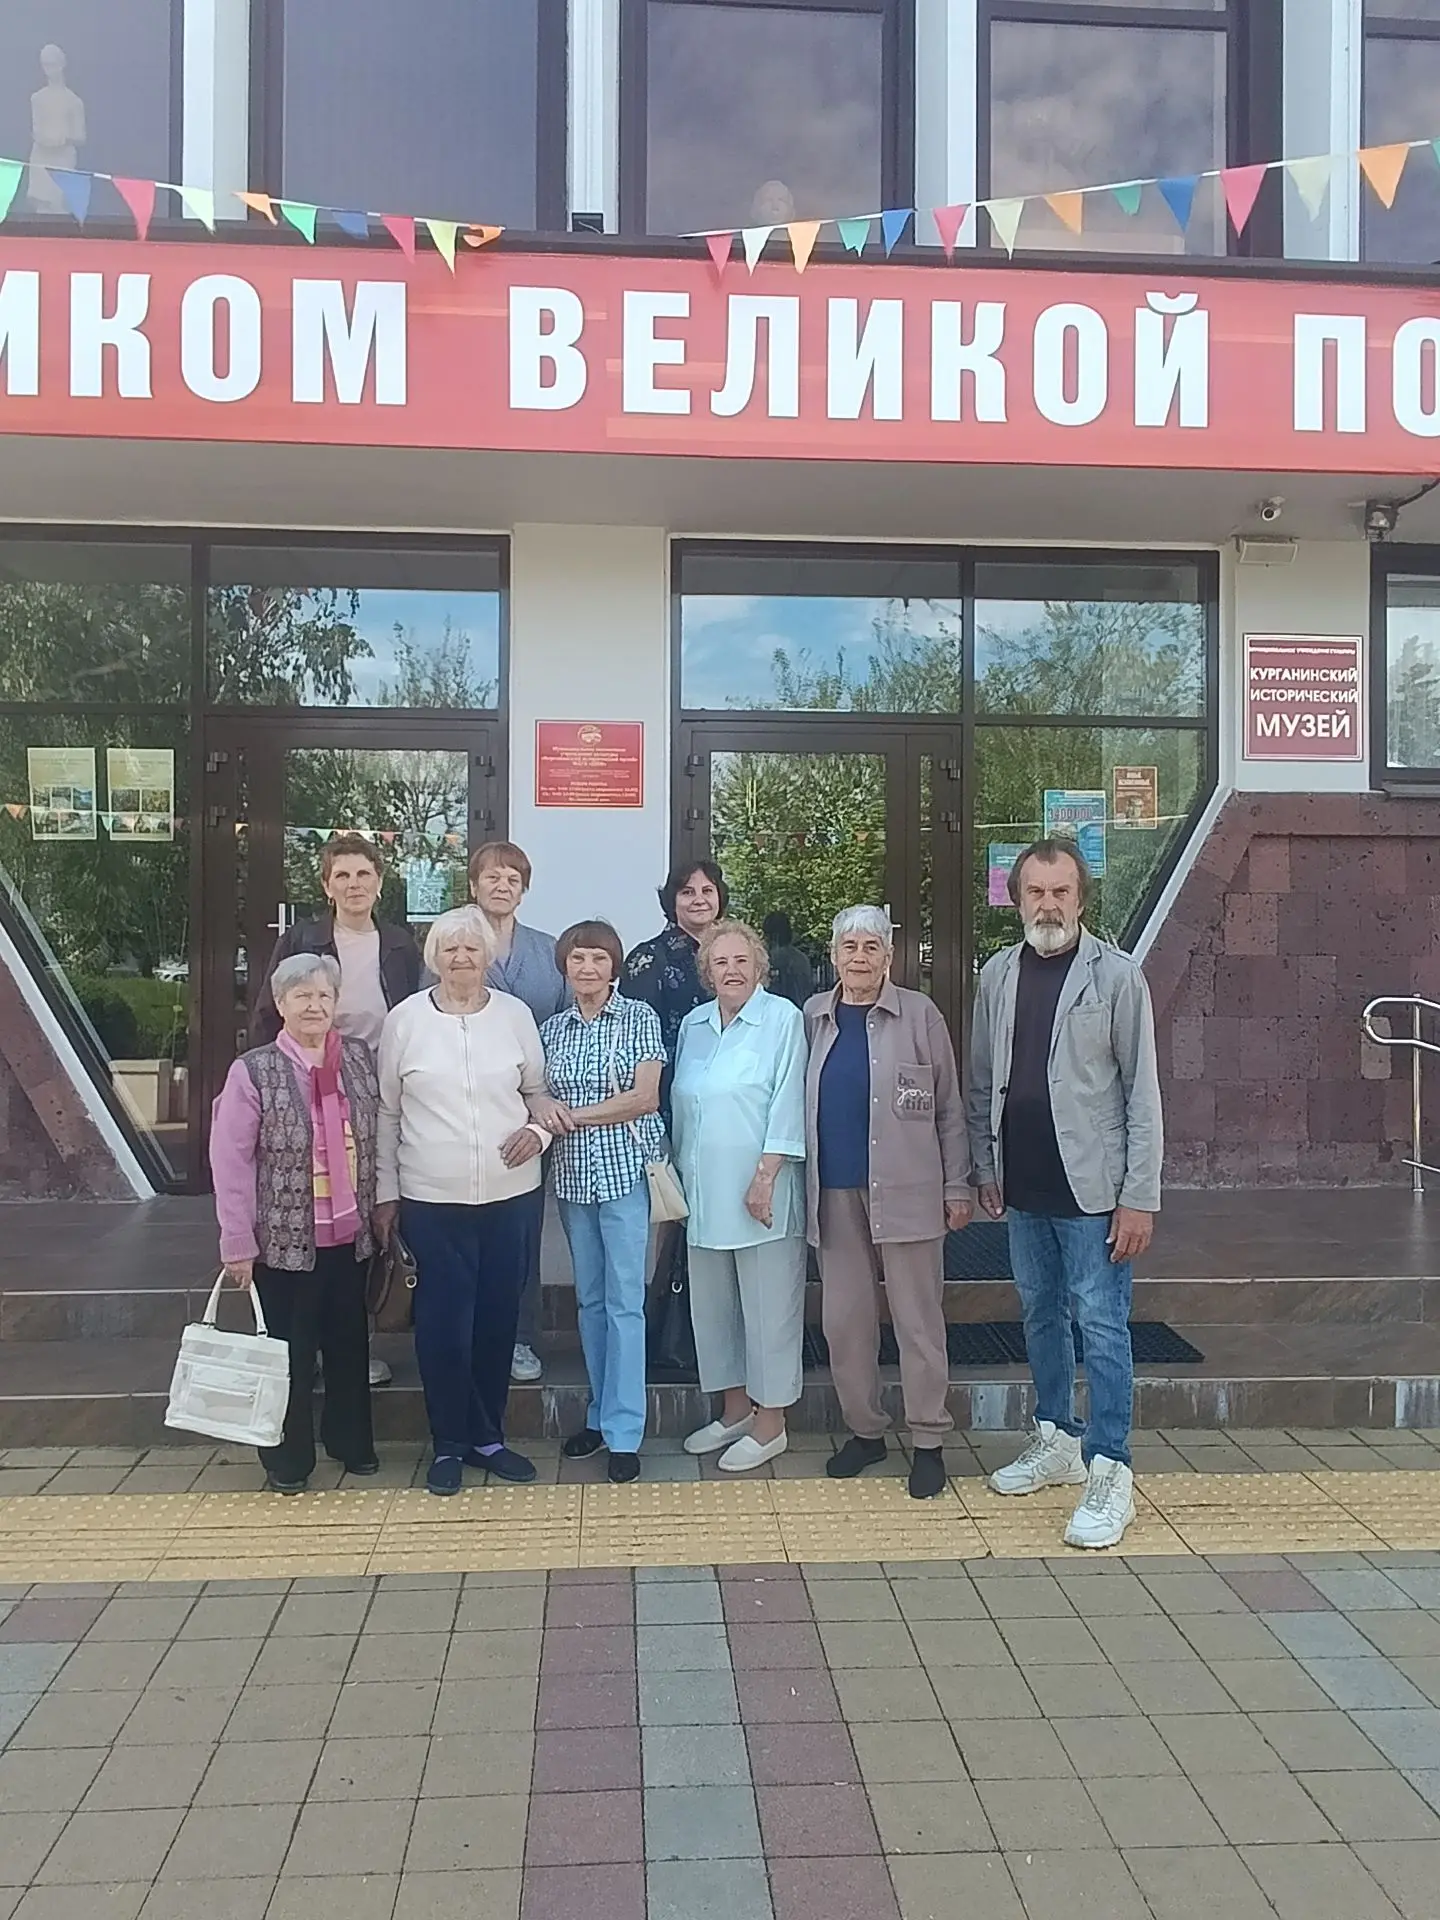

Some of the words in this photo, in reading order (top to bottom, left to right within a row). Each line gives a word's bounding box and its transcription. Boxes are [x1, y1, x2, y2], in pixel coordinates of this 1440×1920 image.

[509, 285, 1209, 429] ВЕЛИКОЙ
[1250, 667, 1359, 682] КУРГАНИНСКИЙ
[1250, 688, 1359, 703] ИСТОРИЧЕСКИЙ
[1256, 709, 1351, 738] МУЗЕЙ
[898, 1072, 916, 1088] be
[896, 1086, 933, 1106] you
[905, 1096, 934, 1111] tiful
